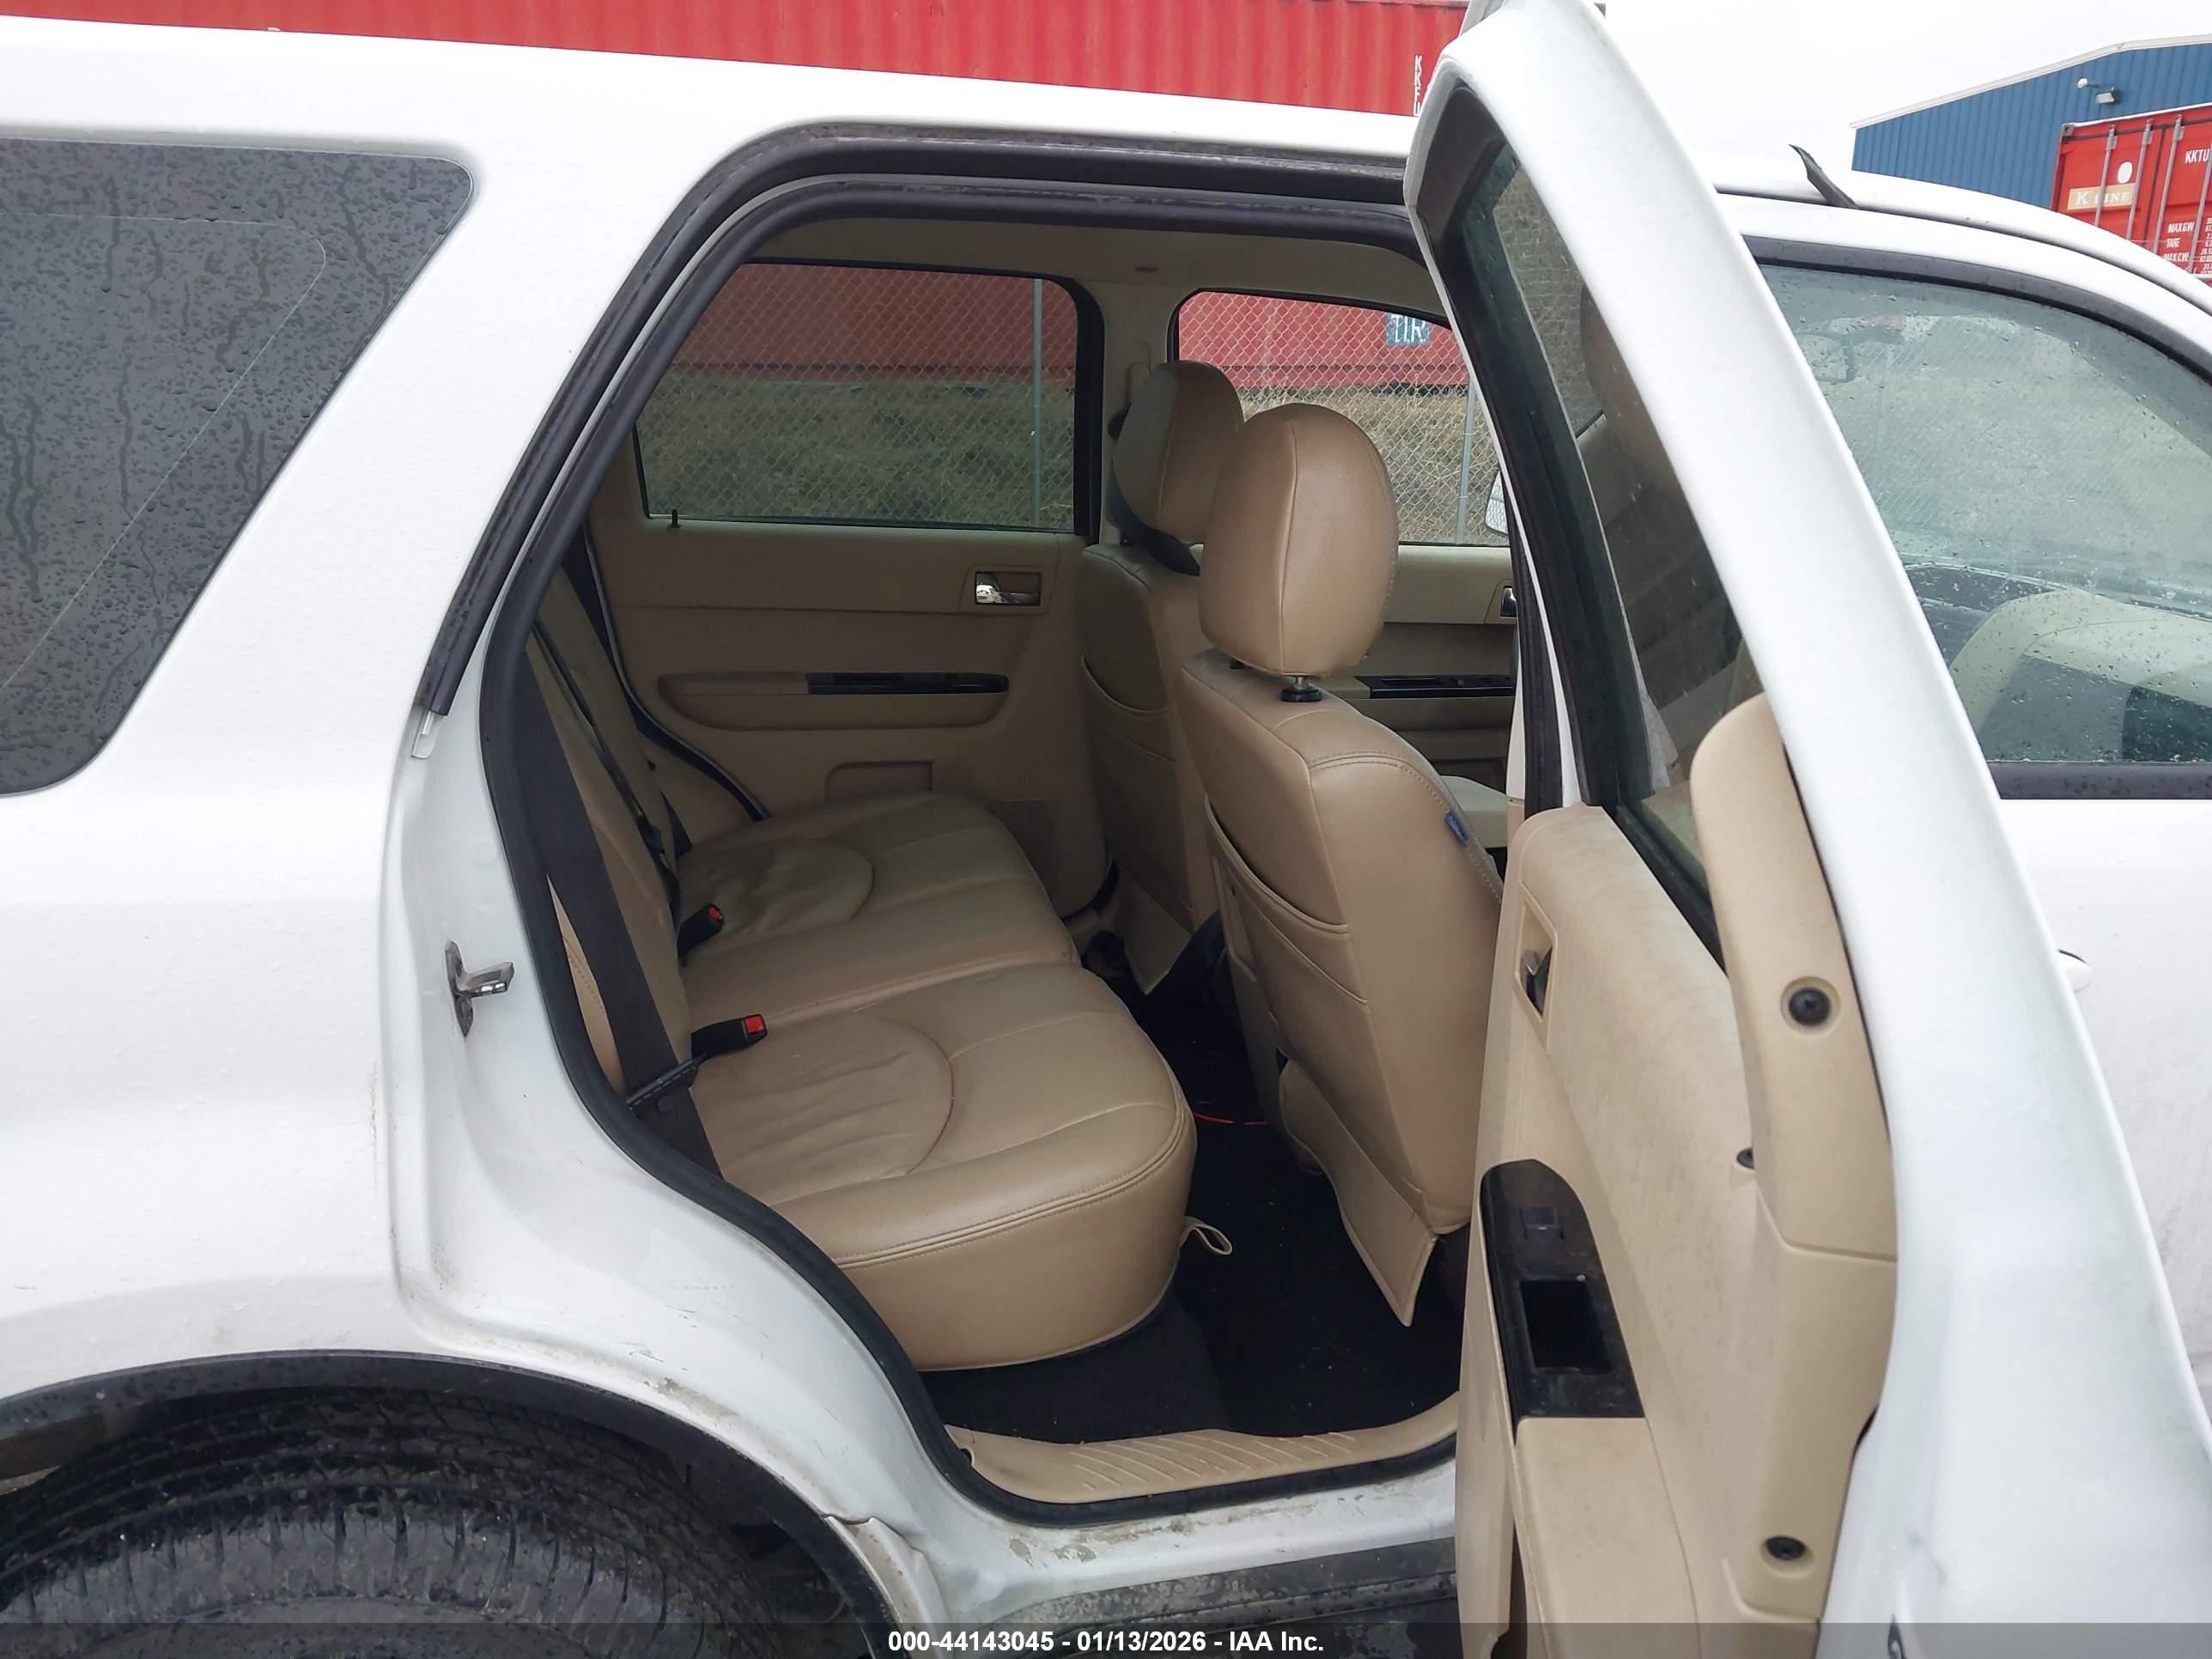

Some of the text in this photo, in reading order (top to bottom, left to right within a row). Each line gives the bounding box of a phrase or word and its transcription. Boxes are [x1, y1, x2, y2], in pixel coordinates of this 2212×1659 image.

[2185, 149, 2210, 164] KKTU
[2075, 191, 2089, 205] K
[2166, 237, 2182, 248] TARE
[1390, 313, 1427, 343] TIR
